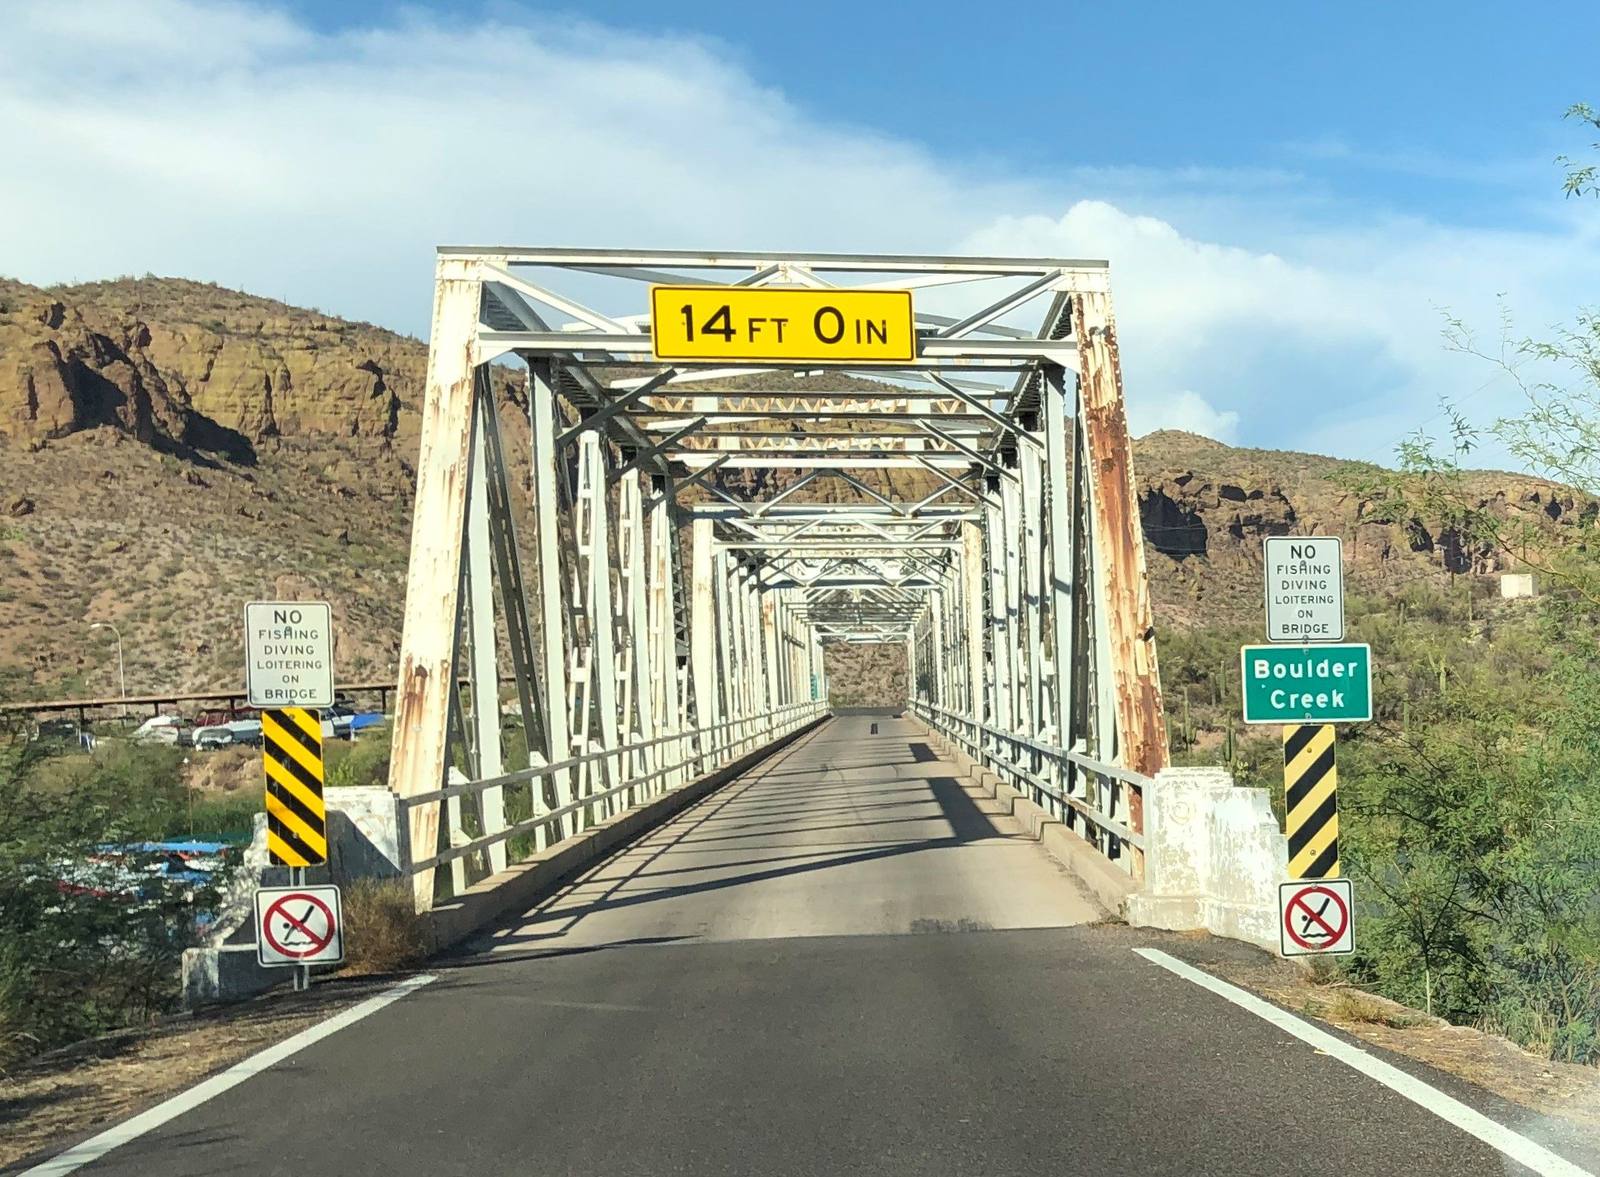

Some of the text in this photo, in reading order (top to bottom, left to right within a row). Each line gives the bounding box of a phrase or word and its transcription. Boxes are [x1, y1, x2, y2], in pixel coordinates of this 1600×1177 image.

[680, 304, 888, 344] 14 FT 0 IN
[1290, 545, 1316, 559] NO
[1276, 564, 1331, 575] FISHING
[1281, 580, 1327, 590] DIVING
[1275, 595, 1334, 604] LOITERING
[274, 610, 302, 624] NO
[1297, 609, 1313, 618] ON
[1282, 624, 1329, 634] BRIDGE
[258, 629, 319, 640] FISHING
[264, 645, 315, 655] DIVING
[257, 660, 322, 670] LOITERING
[1254, 659, 1358, 679] Boulder
[282, 675, 299, 684] ON
[265, 689, 317, 699] BRIDGE
[1270, 689, 1345, 709] Creek
